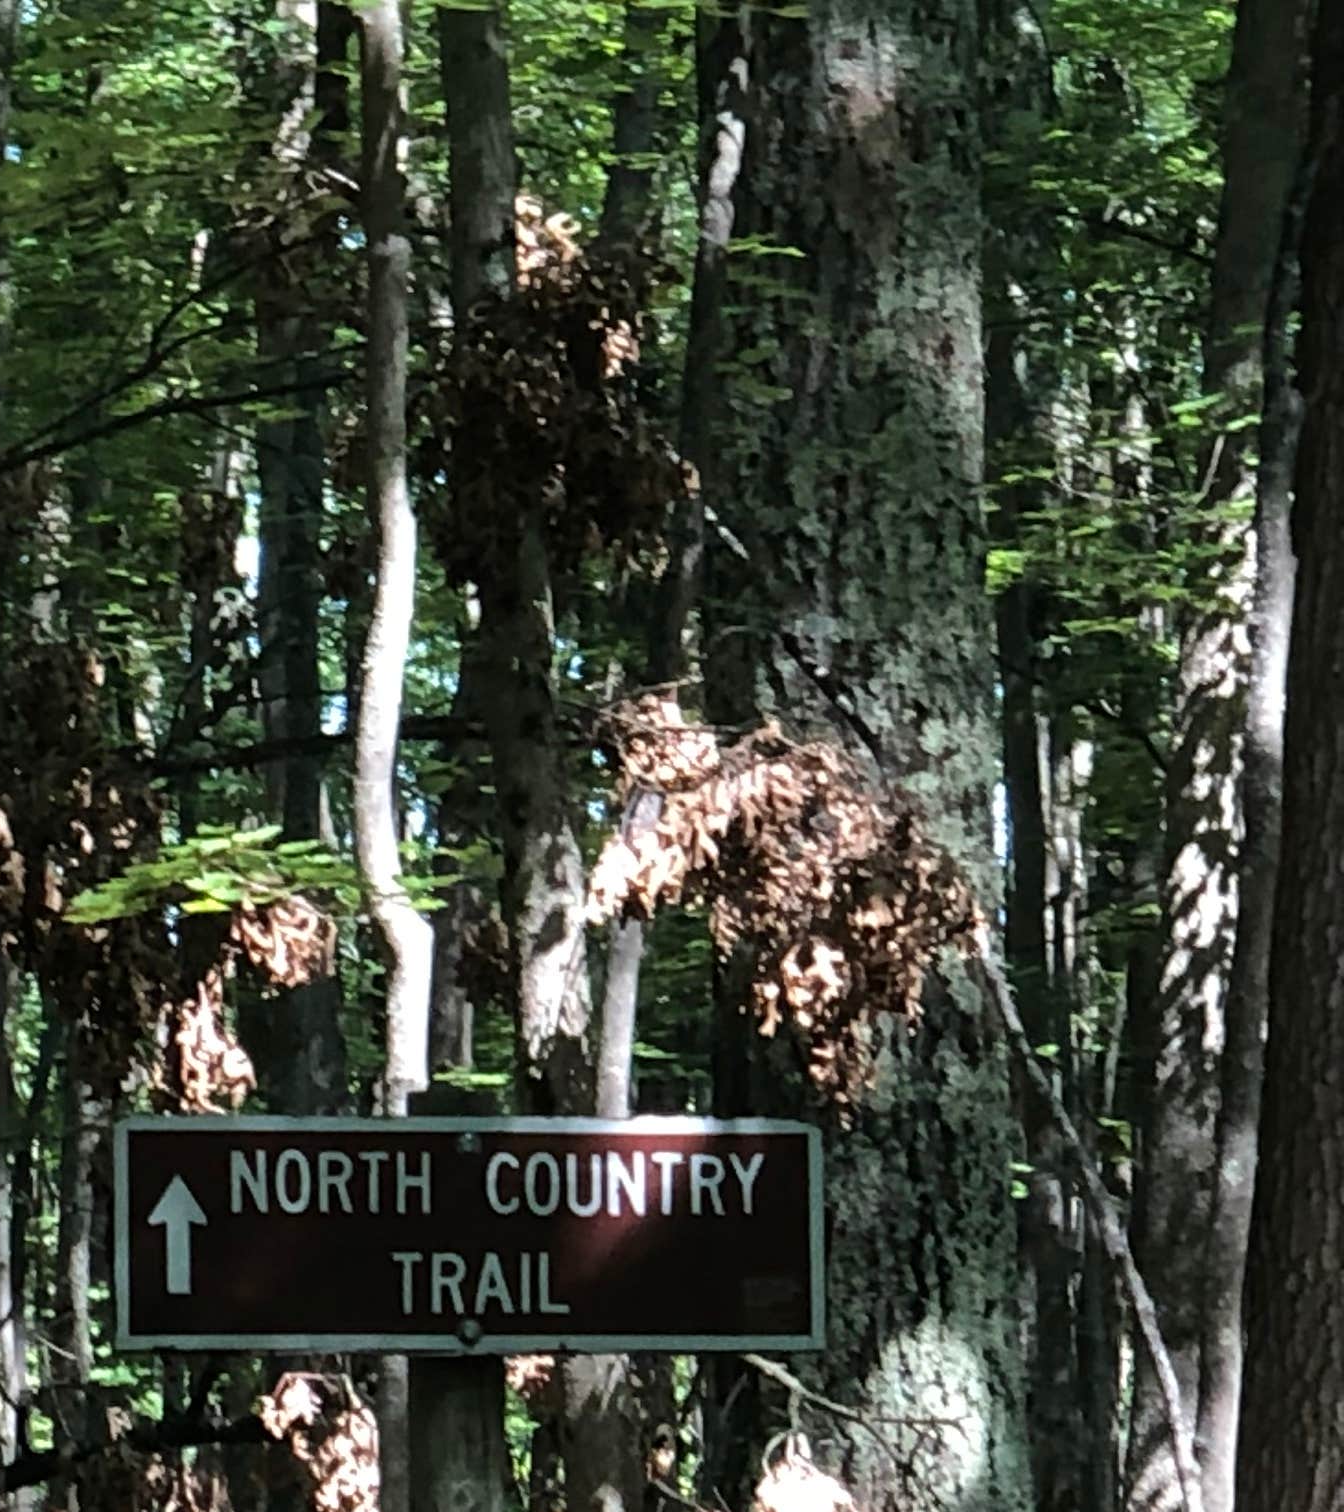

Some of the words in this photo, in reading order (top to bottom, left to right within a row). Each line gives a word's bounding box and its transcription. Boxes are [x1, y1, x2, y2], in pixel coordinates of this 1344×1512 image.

[229, 1149, 432, 1213] NORTH
[486, 1152, 765, 1217] COUNTRY
[392, 1252, 570, 1314] TRAIL
